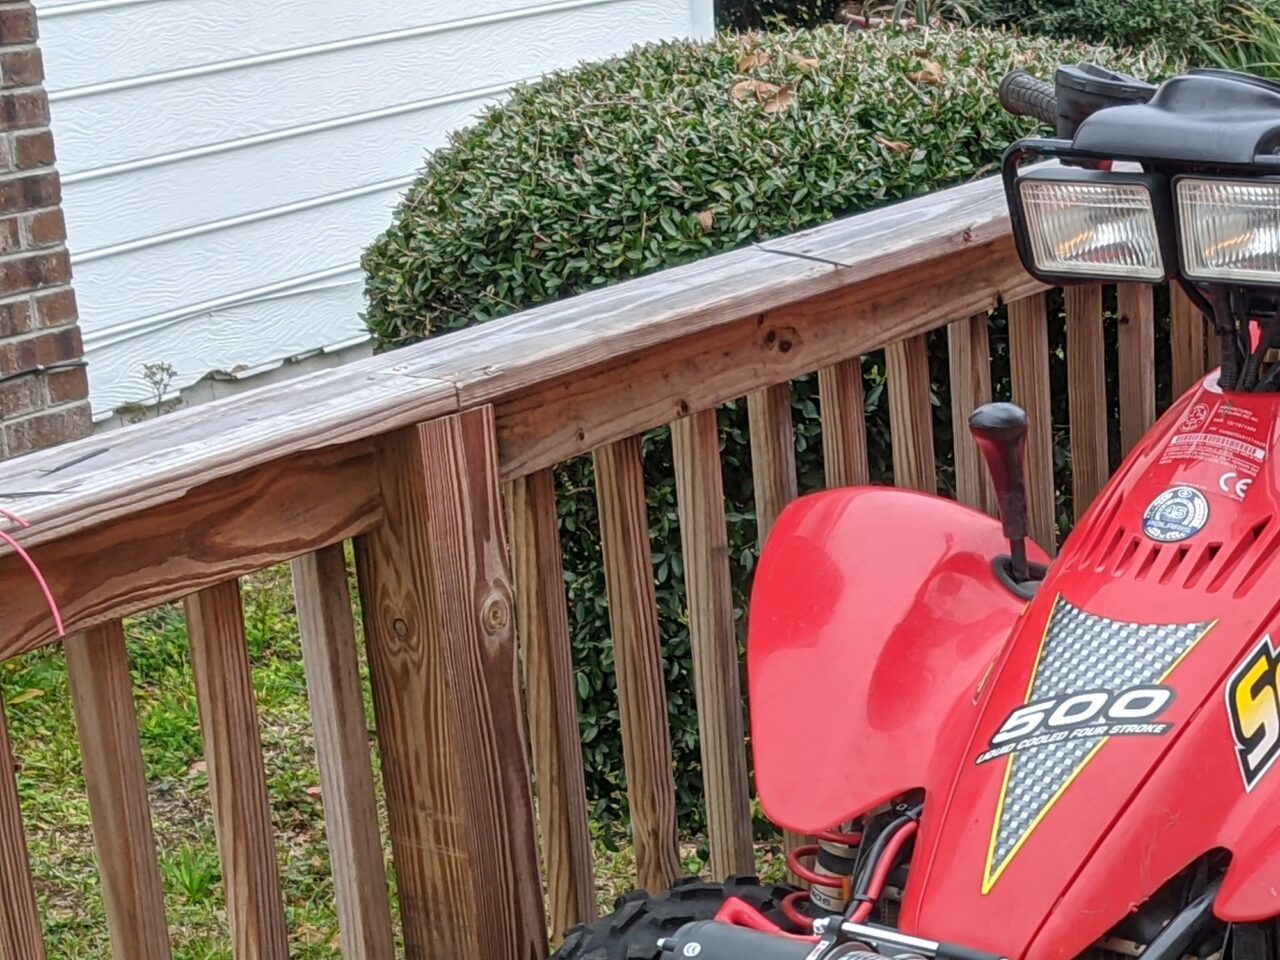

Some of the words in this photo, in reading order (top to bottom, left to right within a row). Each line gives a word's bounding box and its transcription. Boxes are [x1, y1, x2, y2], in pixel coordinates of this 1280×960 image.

[1219, 472, 1252, 498] CE
[992, 689, 1171, 744] 500
[976, 742, 1016, 764] LIQUID
[1017, 731, 1069, 750] COOLED
[1069, 725, 1109, 739] FOUR
[1109, 724, 1167, 735] STROKE
